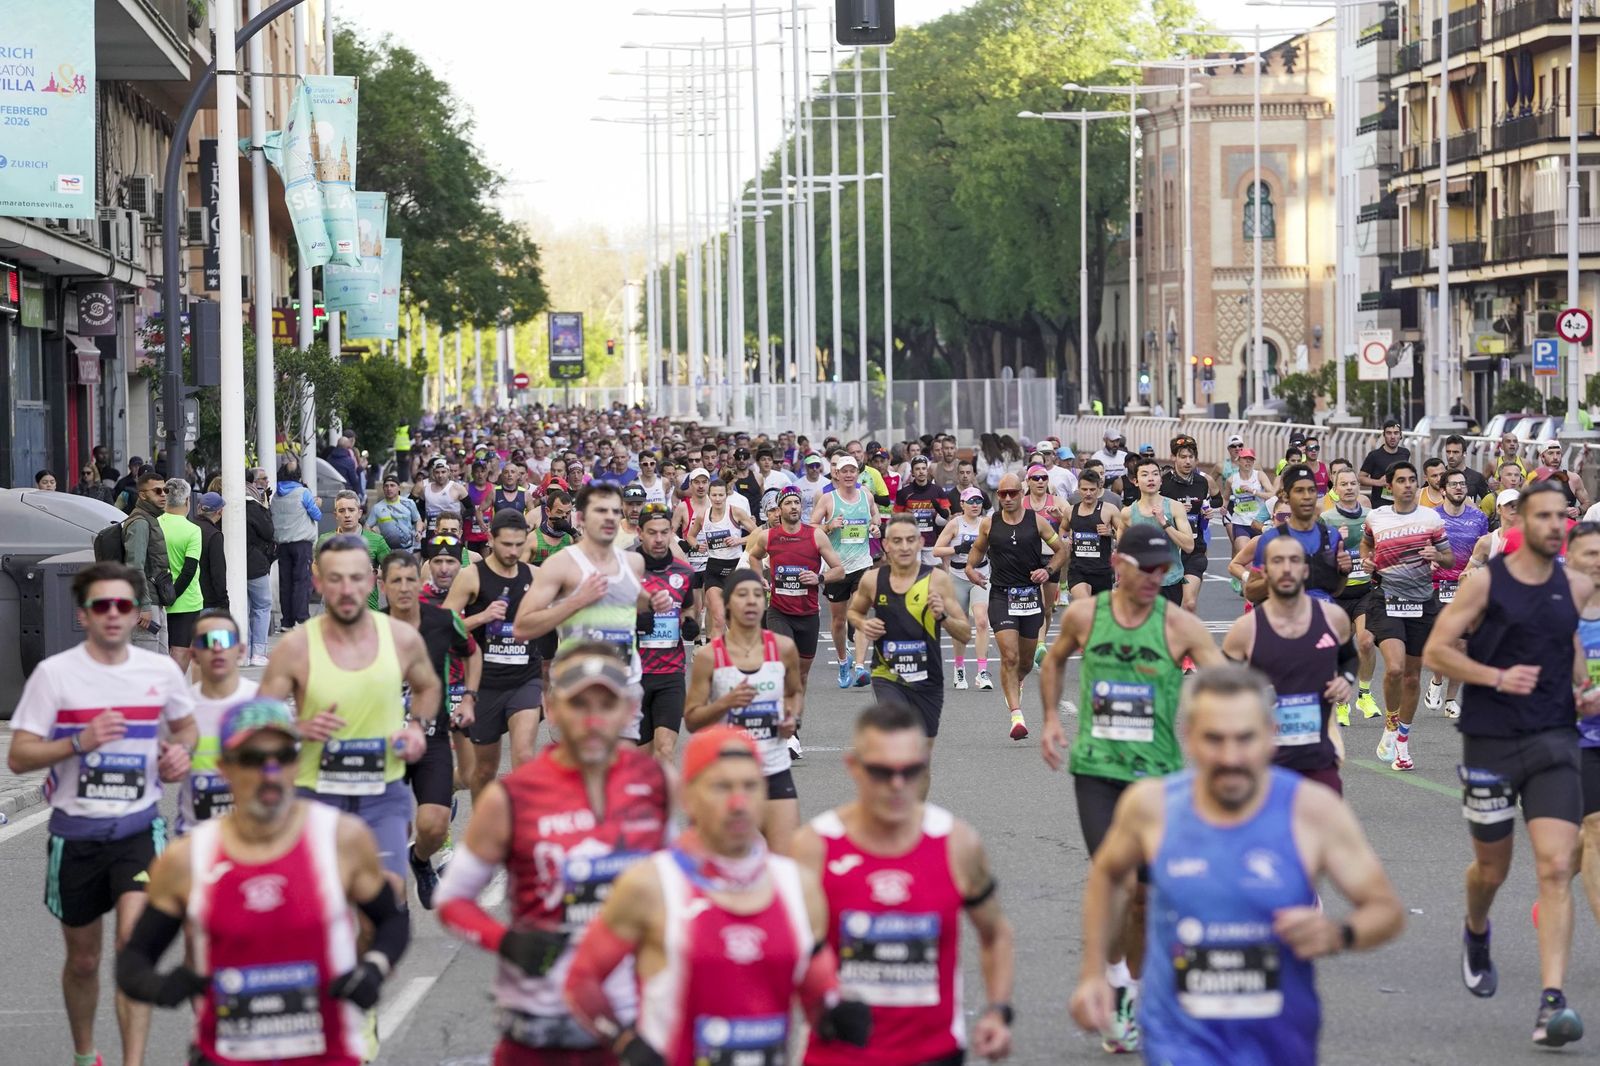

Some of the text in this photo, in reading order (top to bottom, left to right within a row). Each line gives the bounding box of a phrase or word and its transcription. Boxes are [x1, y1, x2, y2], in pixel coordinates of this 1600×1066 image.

[0, 105, 48, 116] FEBRERO
[4, 117, 30, 126] 2026
[10, 160, 49, 169] ZURICH
[0, 200, 74, 209] maratonsevilla.es
[80, 292, 112, 305] TATTOO
[81, 313, 113, 326] PIERCING
[1536, 342, 1552, 361] P
[1376, 526, 1426, 543] JARANA
[1010, 601, 1038, 609] GUSTAVO
[605, 633, 630, 641] ZURICH
[488, 644, 526, 655] RICARDO
[898, 642, 922, 650] ZURICH
[894, 663, 918, 673] FRAN
[1111, 685, 1150, 696] ZURICH
[1281, 695, 1313, 706] ZURICH
[343, 741, 381, 751] ZURICH
[103, 755, 142, 767] ZURICH
[85, 783, 138, 799] DAMIEN
